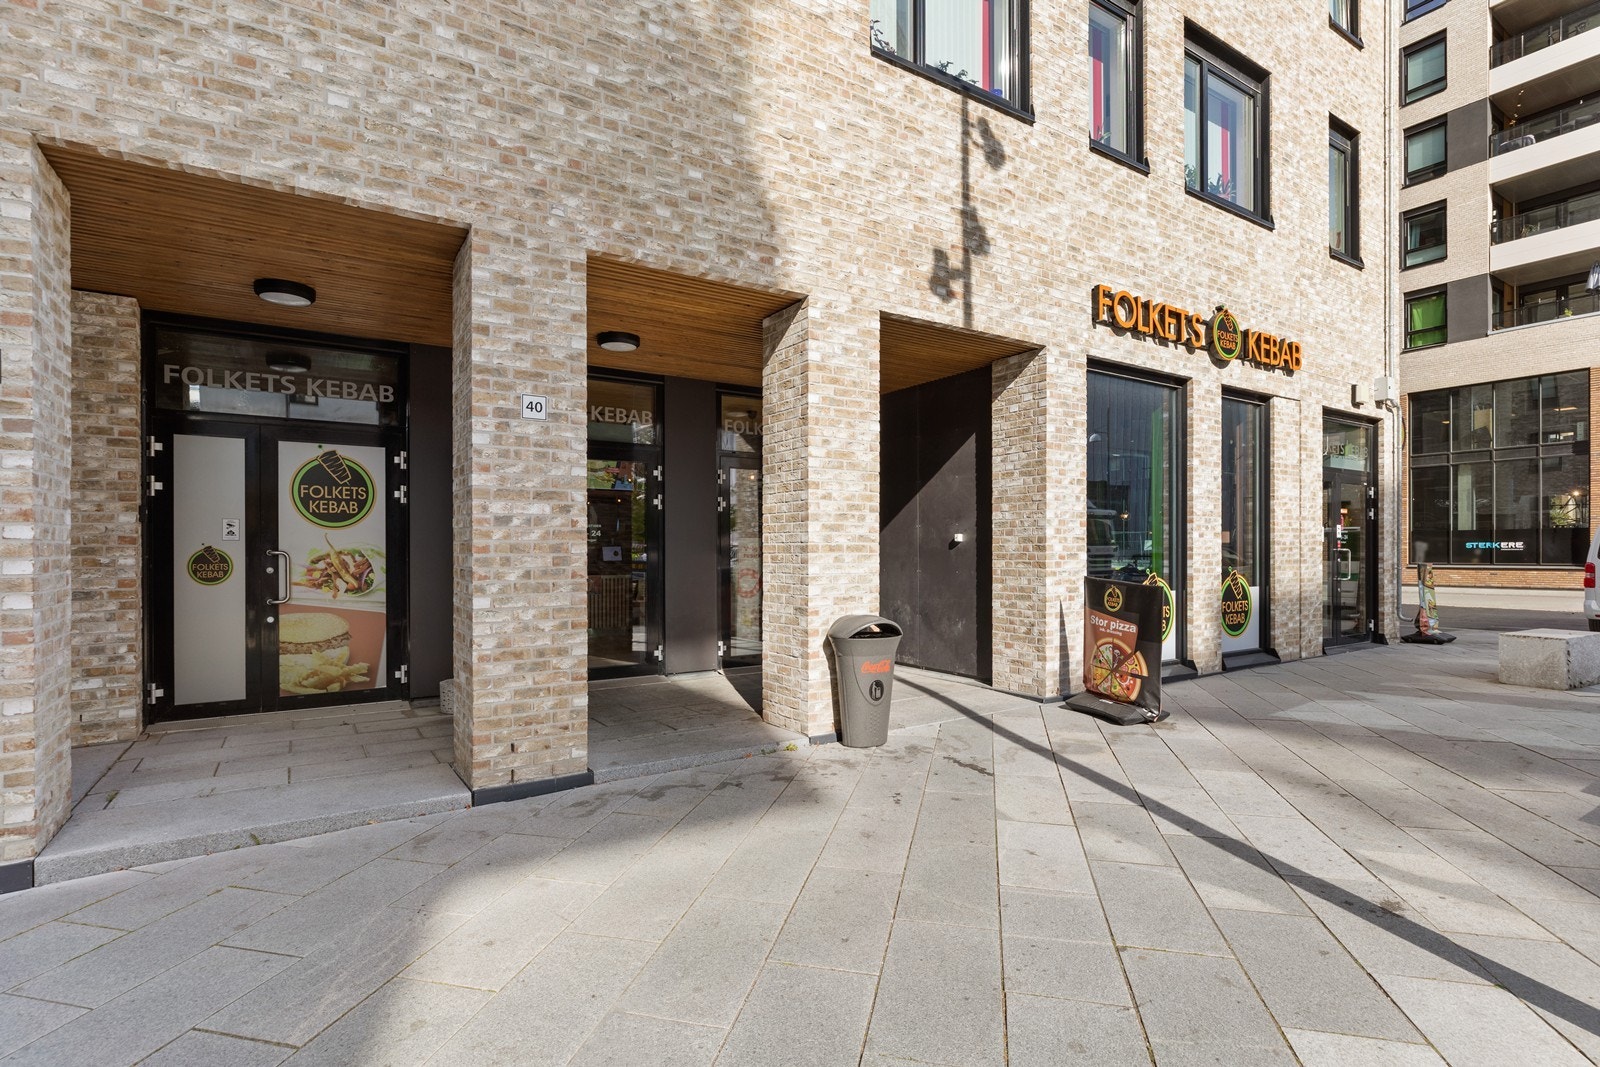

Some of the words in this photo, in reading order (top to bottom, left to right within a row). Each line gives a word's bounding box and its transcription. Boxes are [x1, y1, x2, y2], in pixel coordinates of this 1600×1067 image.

[1098, 283, 1204, 348] FOLKETS
[1248, 328, 1303, 371] KEBAB
[163, 364, 296, 395] FOLKETS
[306, 378, 395, 403] KEBAB
[525, 401, 543, 413] 40
[590, 405, 653, 425] KEBAB
[300, 484, 367, 500] FOLKETS
[308, 500, 359, 514] KEBAB
[1465, 541, 1524, 549] STERKERE
[192, 562, 229, 572] FOLKETS
[196, 570, 224, 579] KEBAB
[1222, 600, 1249, 613] FOLKETS
[1090, 615, 1108, 627] Stor
[1110, 620, 1137, 633] pizza
[1225, 613, 1245, 625] KEBAB
